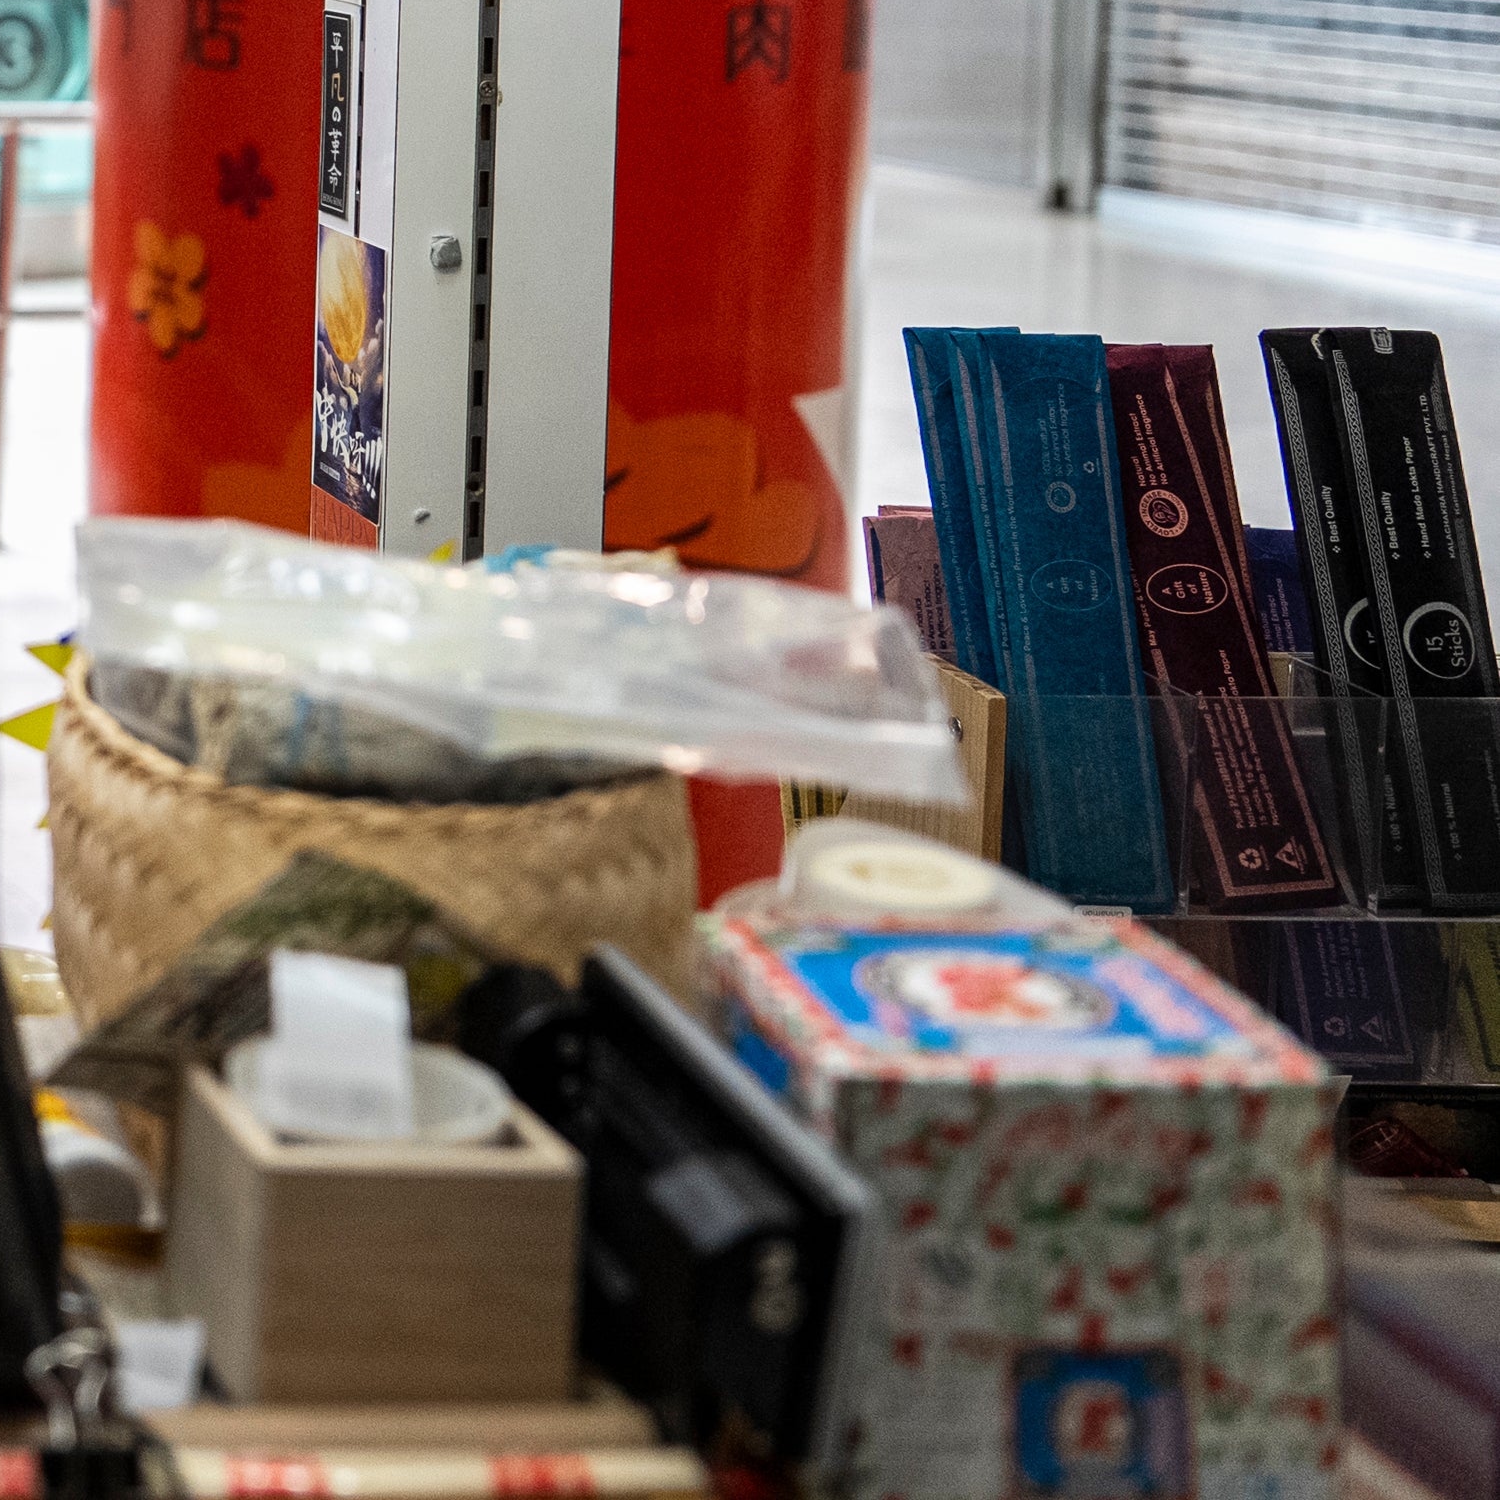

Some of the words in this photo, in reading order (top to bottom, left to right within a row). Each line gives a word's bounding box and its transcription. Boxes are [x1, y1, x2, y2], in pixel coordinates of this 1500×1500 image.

[1128, 411, 1143, 441] Extract
[1134, 392, 1154, 435] fragrance
[1422, 413, 1433, 434] PVT.
[1137, 442, 1153, 472] Animal
[1147, 435, 1164, 472] Artificial
[1401, 435, 1415, 464] Paper
[1441, 433, 1452, 460] Nepal
[1130, 454, 1146, 487] Natural
[1426, 434, 1444, 493] HANDICRAFT
[1147, 472, 1157, 486] No
[1158, 472, 1168, 485] No
[1407, 465, 1419, 492] Lokta
[937, 483, 949, 508] World
[976, 486, 988, 512] World
[1004, 488, 1016, 515] World
[1320, 484, 1335, 518] Quality
[1379, 490, 1395, 524] Quality
[1412, 494, 1424, 520] Made
[981, 513, 990, 527] the
[984, 529, 992, 537] in
[1007, 516, 1017, 529] the
[1327, 520, 1340, 542] Best
[1438, 494, 1456, 558] KALACHAKRA
[1010, 531, 1018, 539] in
[1386, 526, 1399, 549] Best
[1417, 521, 1430, 548] Hand
[985, 538, 998, 568] Prevail
[1009, 541, 1022, 571] Prevail
[930, 562, 944, 604] fragrance
[992, 569, 1001, 587] may
[1016, 573, 1025, 591] may
[1059, 575, 1069, 593] Gift
[1074, 579, 1083, 590] of
[1088, 568, 1099, 600] Nature
[1161, 586, 1171, 595] A
[1173, 579, 1186, 599] Gift
[1186, 581, 1198, 594] of
[1198, 570, 1214, 604] Nature
[993, 589, 1005, 610] Love
[1016, 593, 1027, 614] Love
[1267, 593, 1279, 622] Extract
[1276, 577, 1290, 617] fragrance
[926, 609, 936, 639] Animal
[934, 606, 946, 639] Artificial
[1138, 602, 1151, 628] Peace
[998, 621, 1010, 647] Peace
[1020, 624, 1032, 651] Peace
[1146, 628, 1158, 646] May
[1425, 635, 1444, 652] 15
[1443, 618, 1466, 667] Sticks
[1216, 647, 1233, 675] Paper
[1382, 774, 1396, 809] Natural
[1440, 782, 1455, 819] Natural
[1389, 823, 1400, 839] 100
[1448, 820, 1456, 829] %
[1449, 831, 1460, 848] 100
